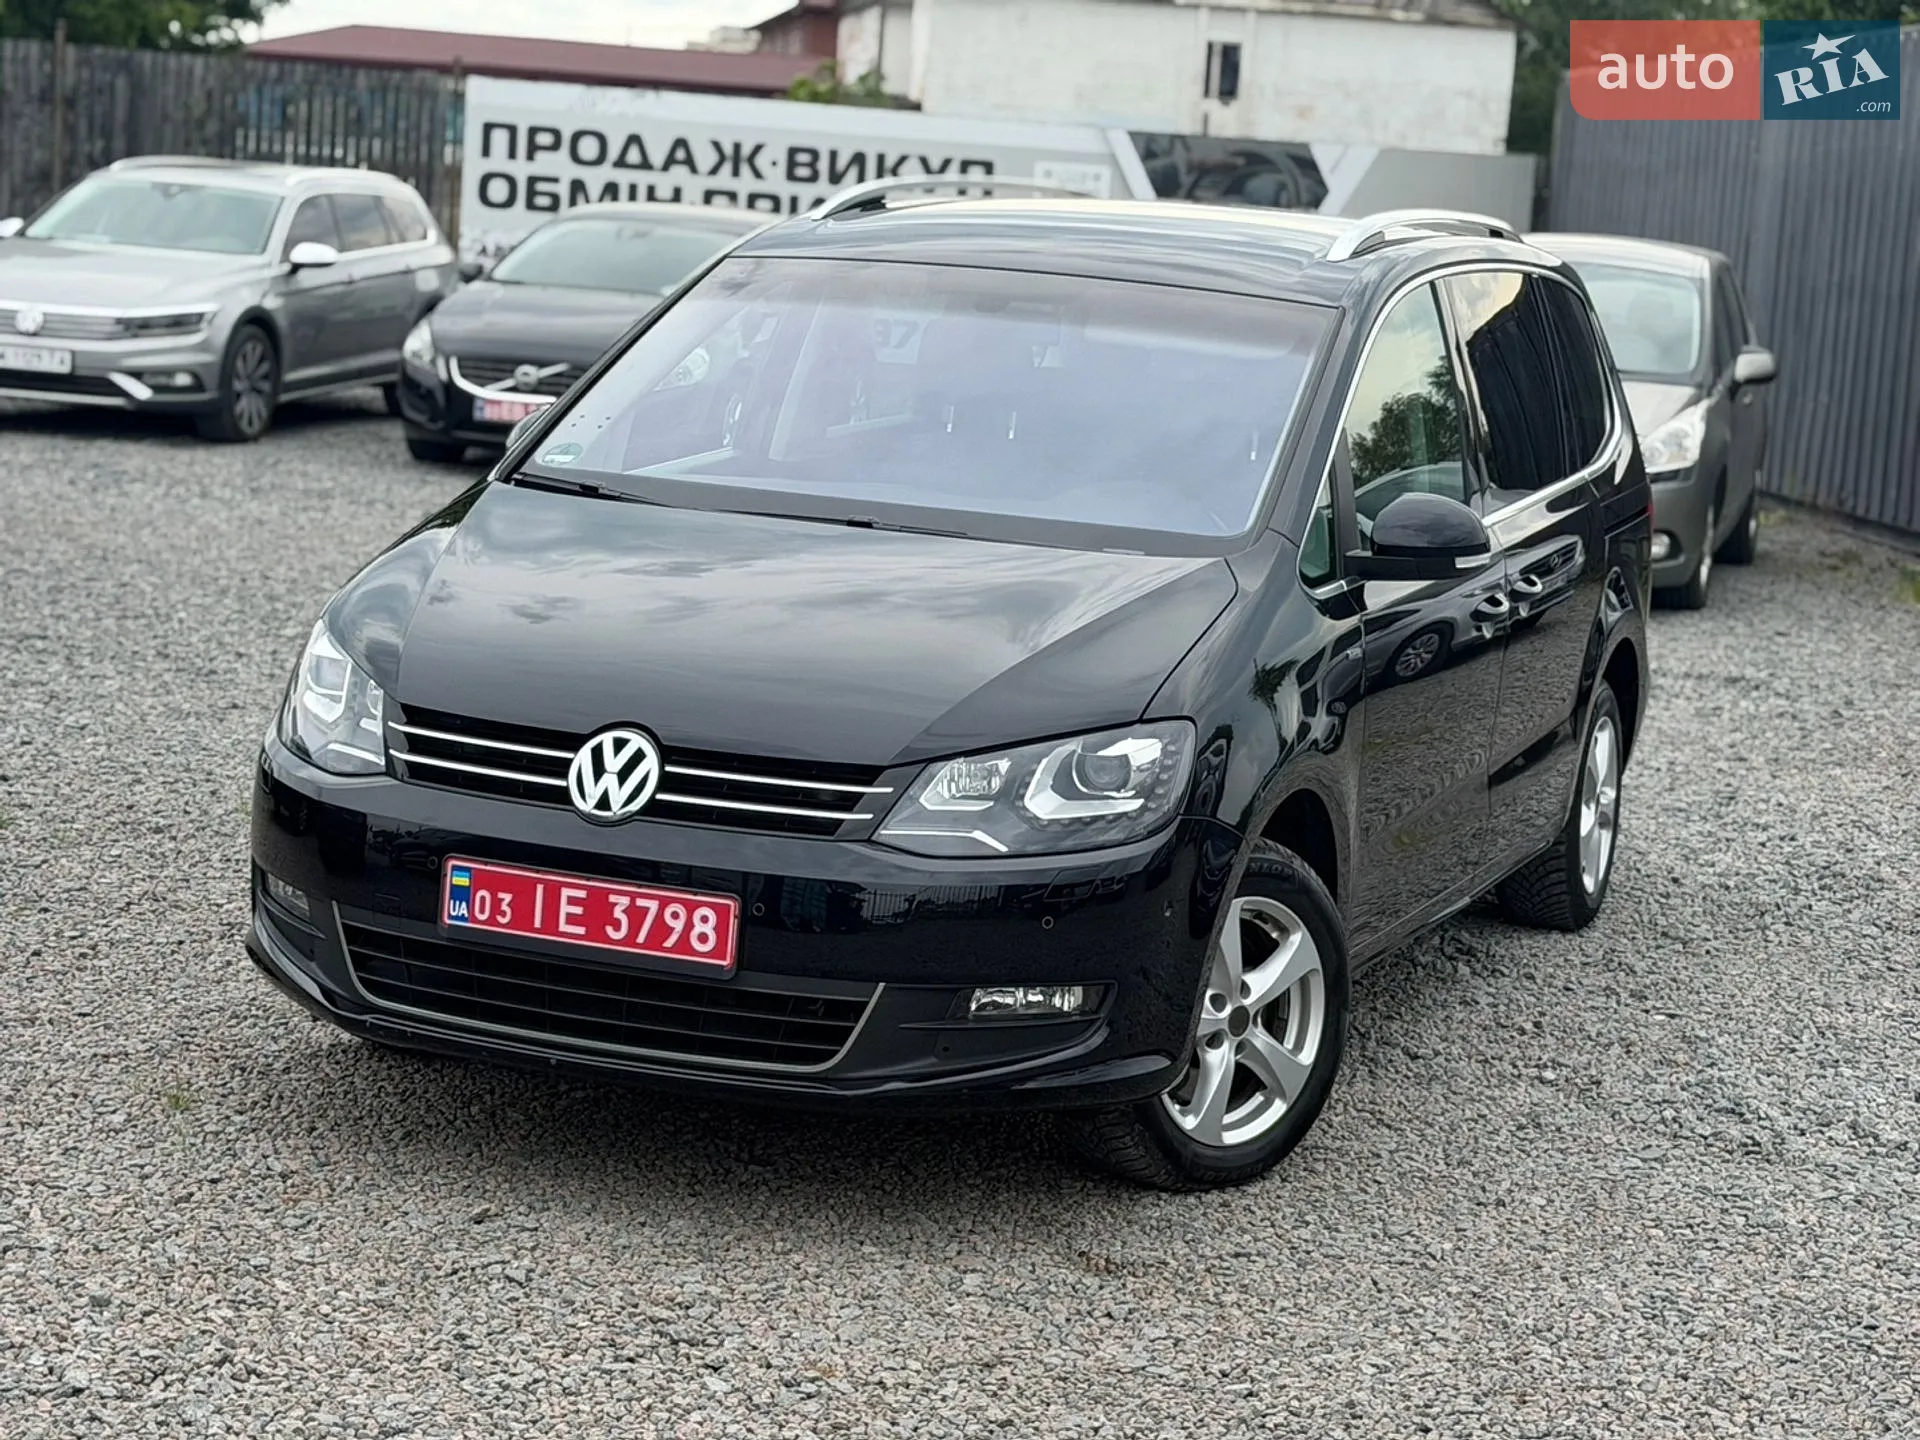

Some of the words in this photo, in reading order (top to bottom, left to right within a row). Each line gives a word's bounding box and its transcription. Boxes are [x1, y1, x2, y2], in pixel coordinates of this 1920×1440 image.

[450, 899, 468, 919] UA
[474, 889, 514, 925] 03
[533, 884, 588, 936] IE
[604, 893, 718, 953] 3798
